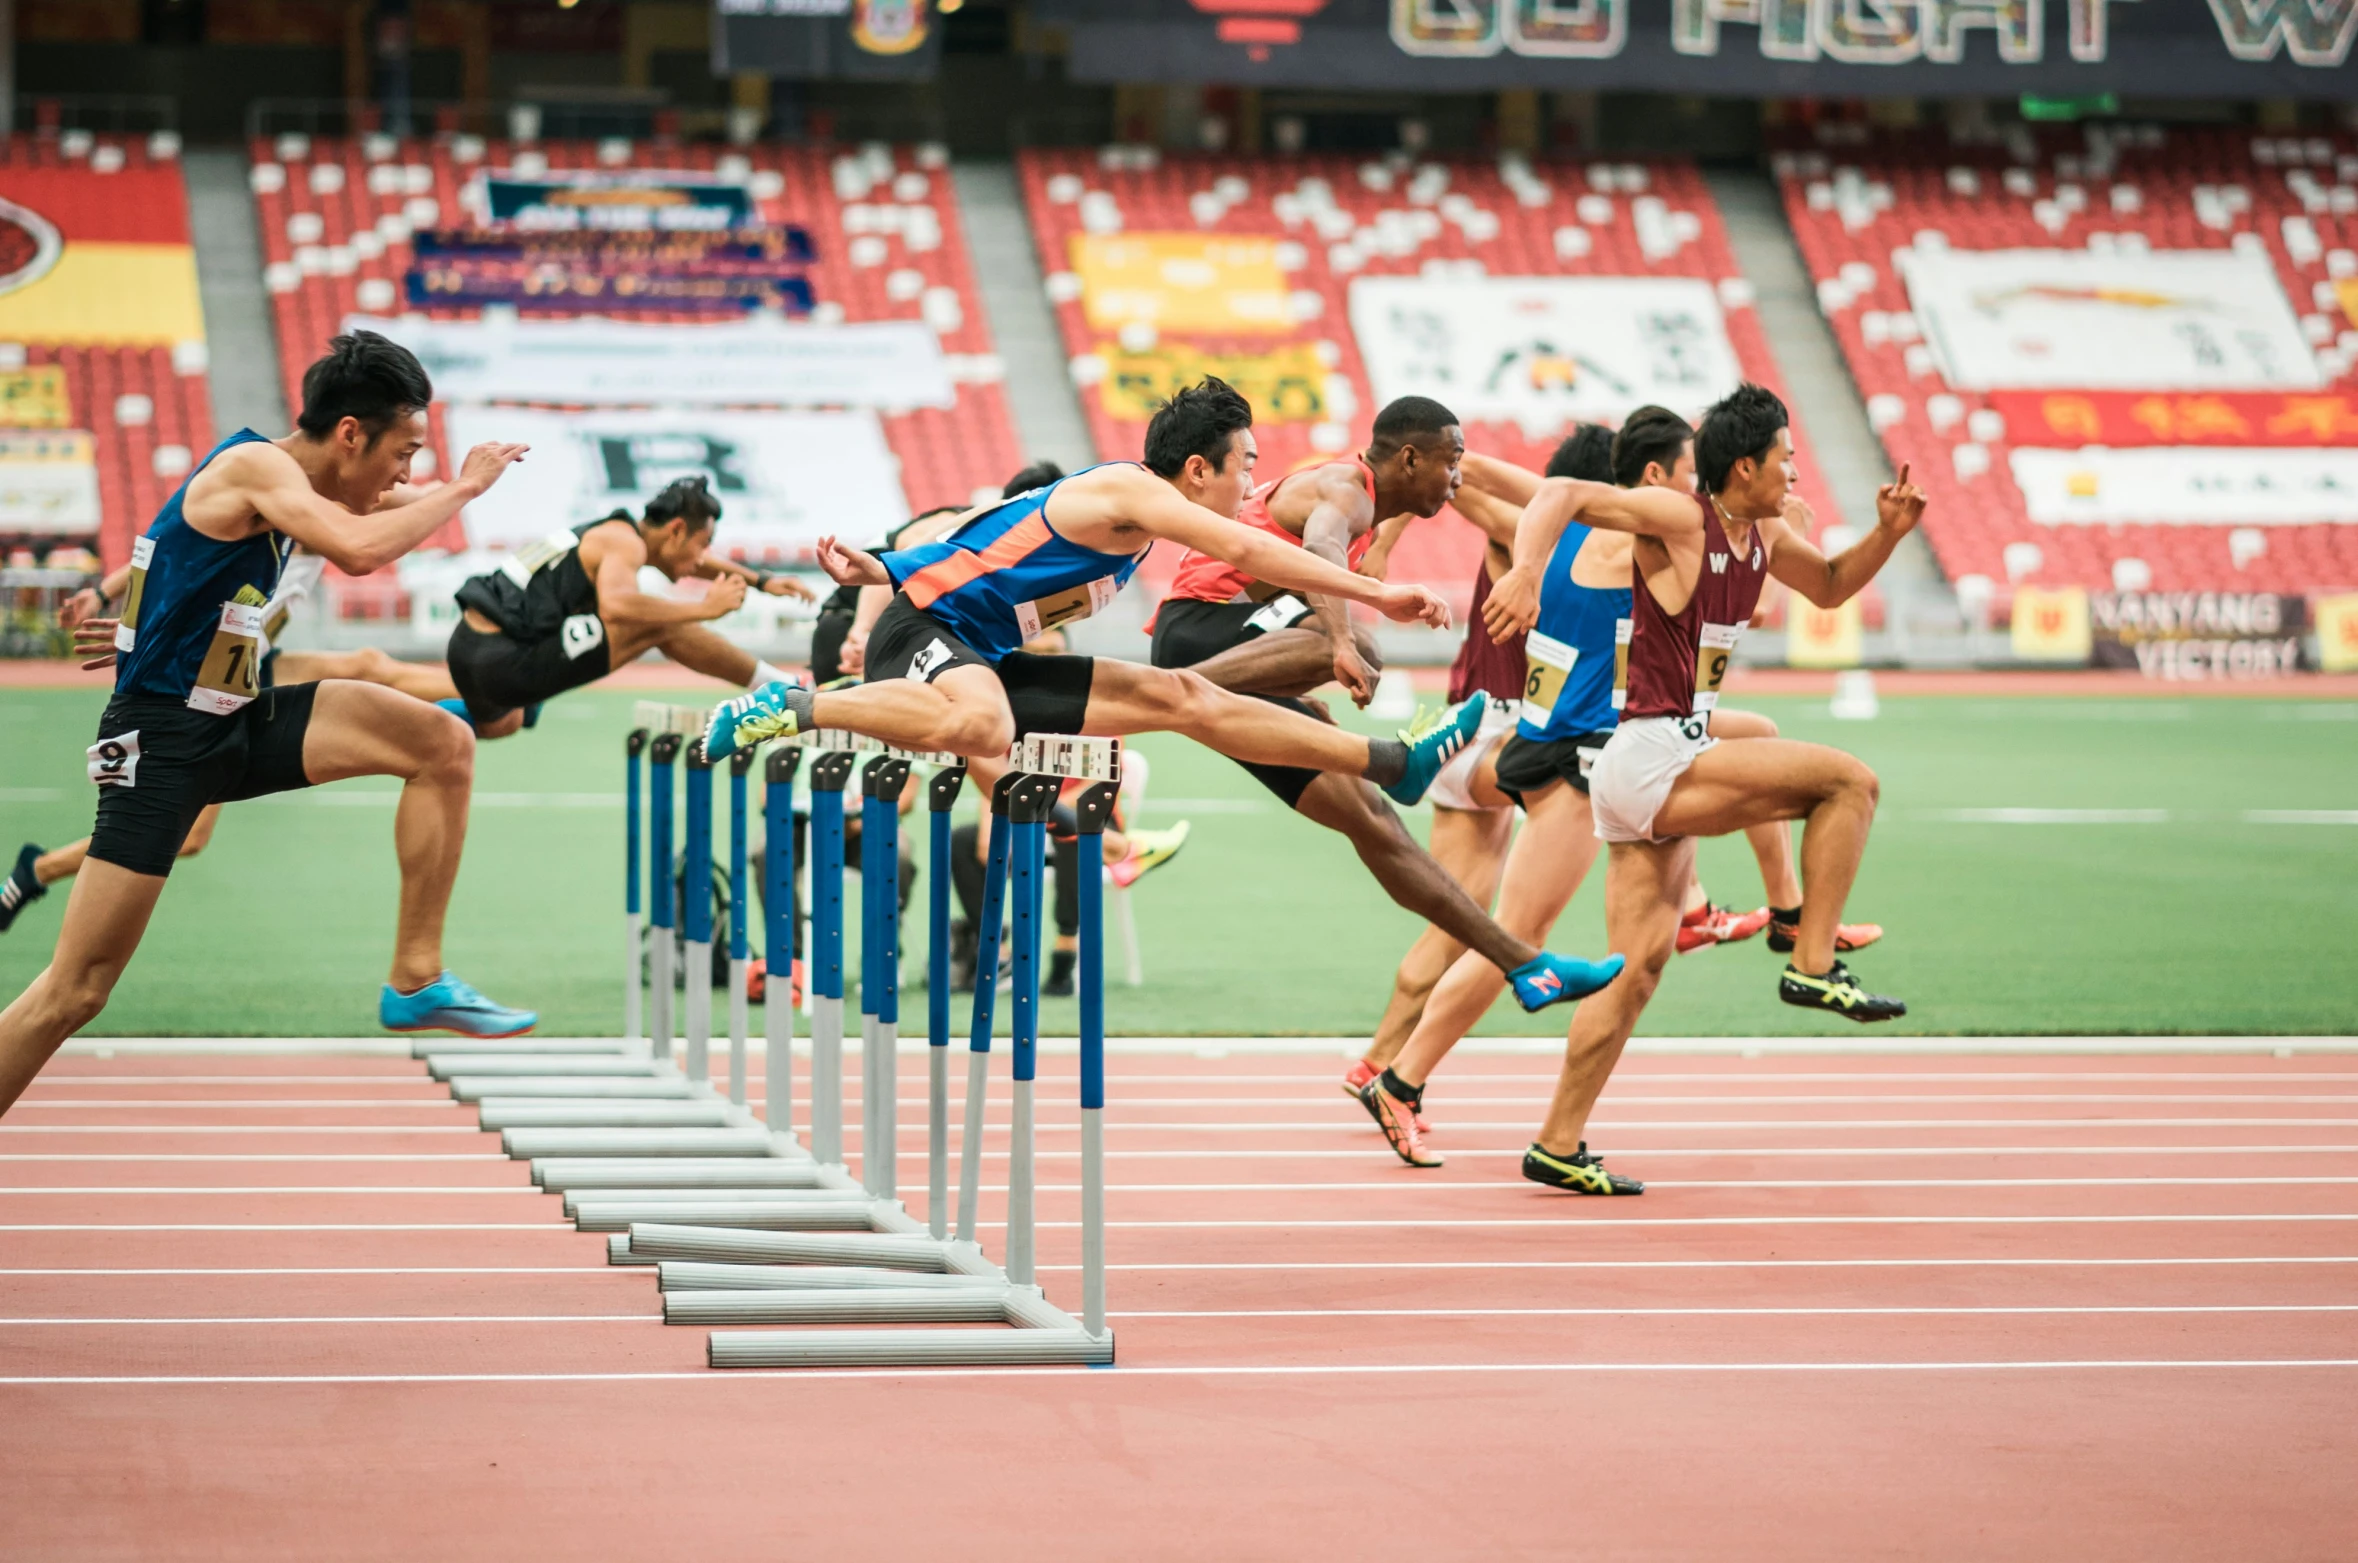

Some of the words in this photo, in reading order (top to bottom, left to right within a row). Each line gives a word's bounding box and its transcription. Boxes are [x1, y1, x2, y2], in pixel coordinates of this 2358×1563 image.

[1709, 552, 1728, 574] W
[2093, 591, 2282, 633] NANYANG
[2134, 637, 2298, 681] VICTORY
